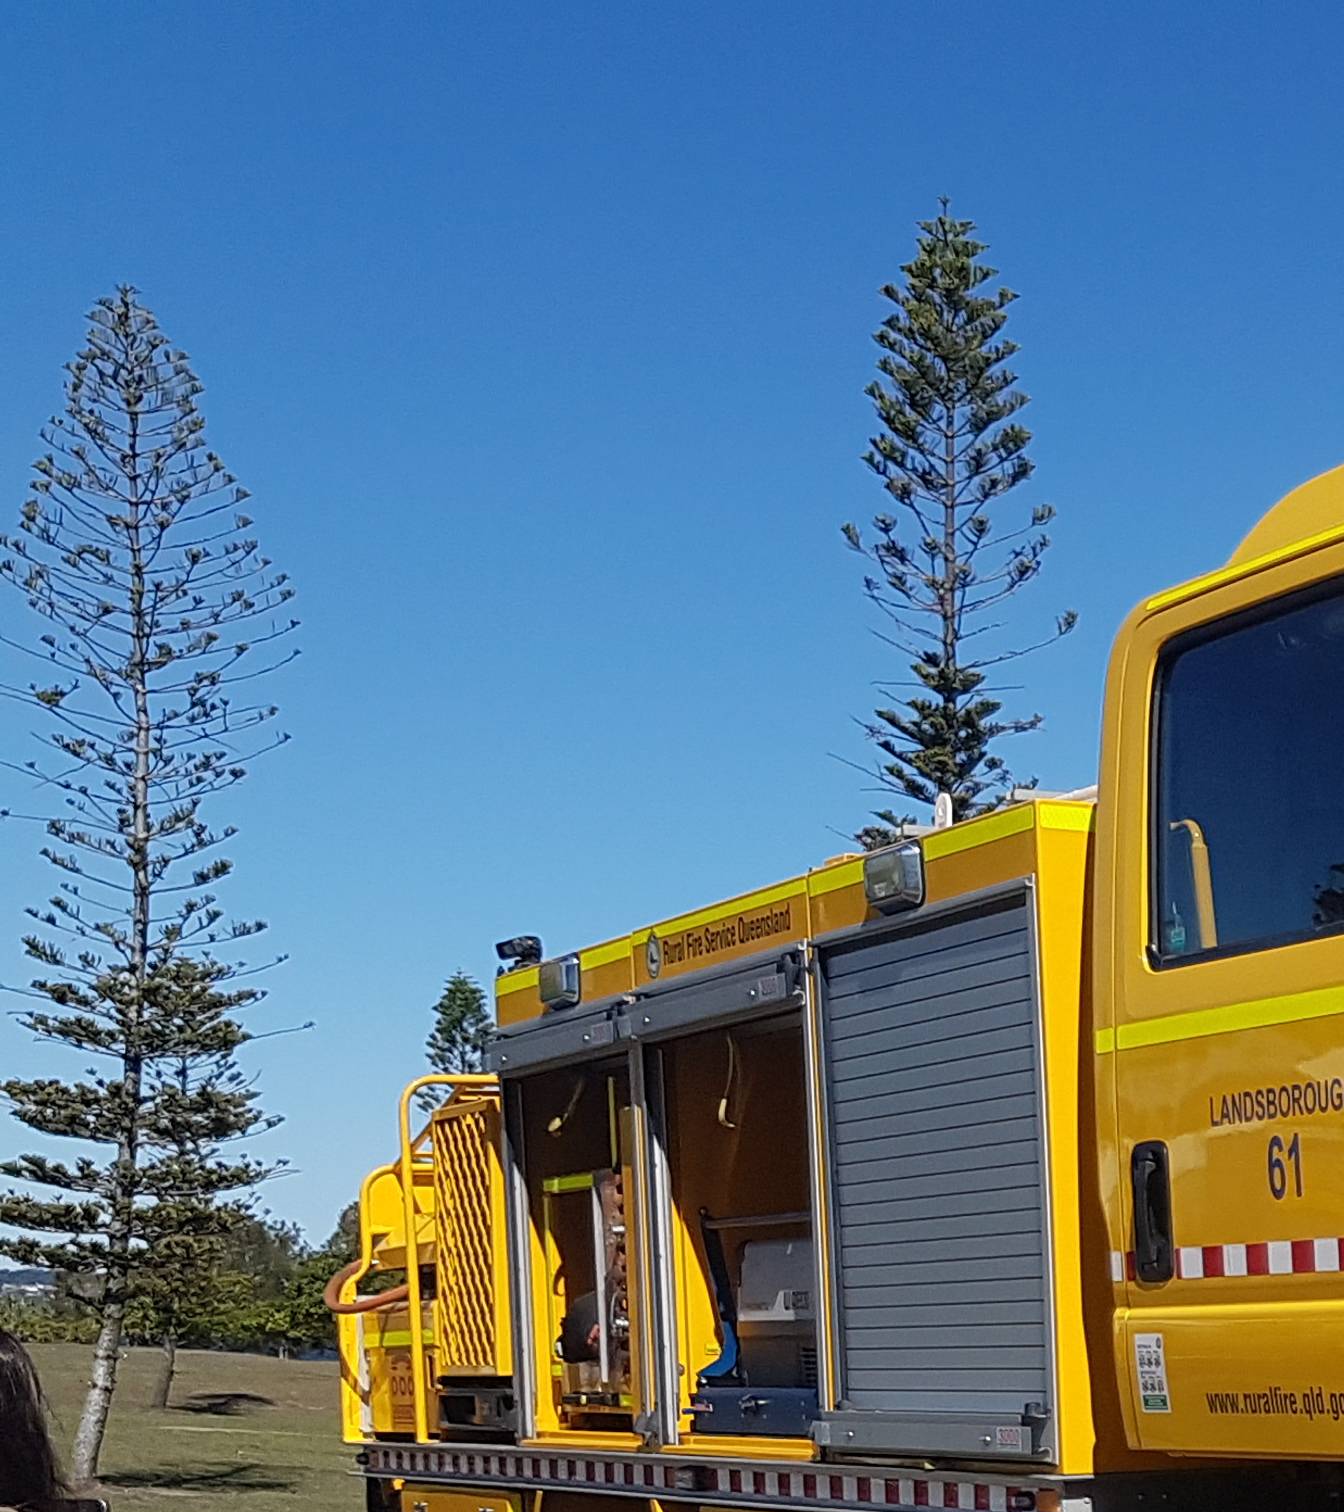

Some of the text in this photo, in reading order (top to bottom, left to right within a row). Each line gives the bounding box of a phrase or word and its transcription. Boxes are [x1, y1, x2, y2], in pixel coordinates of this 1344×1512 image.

[663, 902, 791, 965] Rural Fire Service Queensland
[1268, 1132, 1302, 1200] 61
